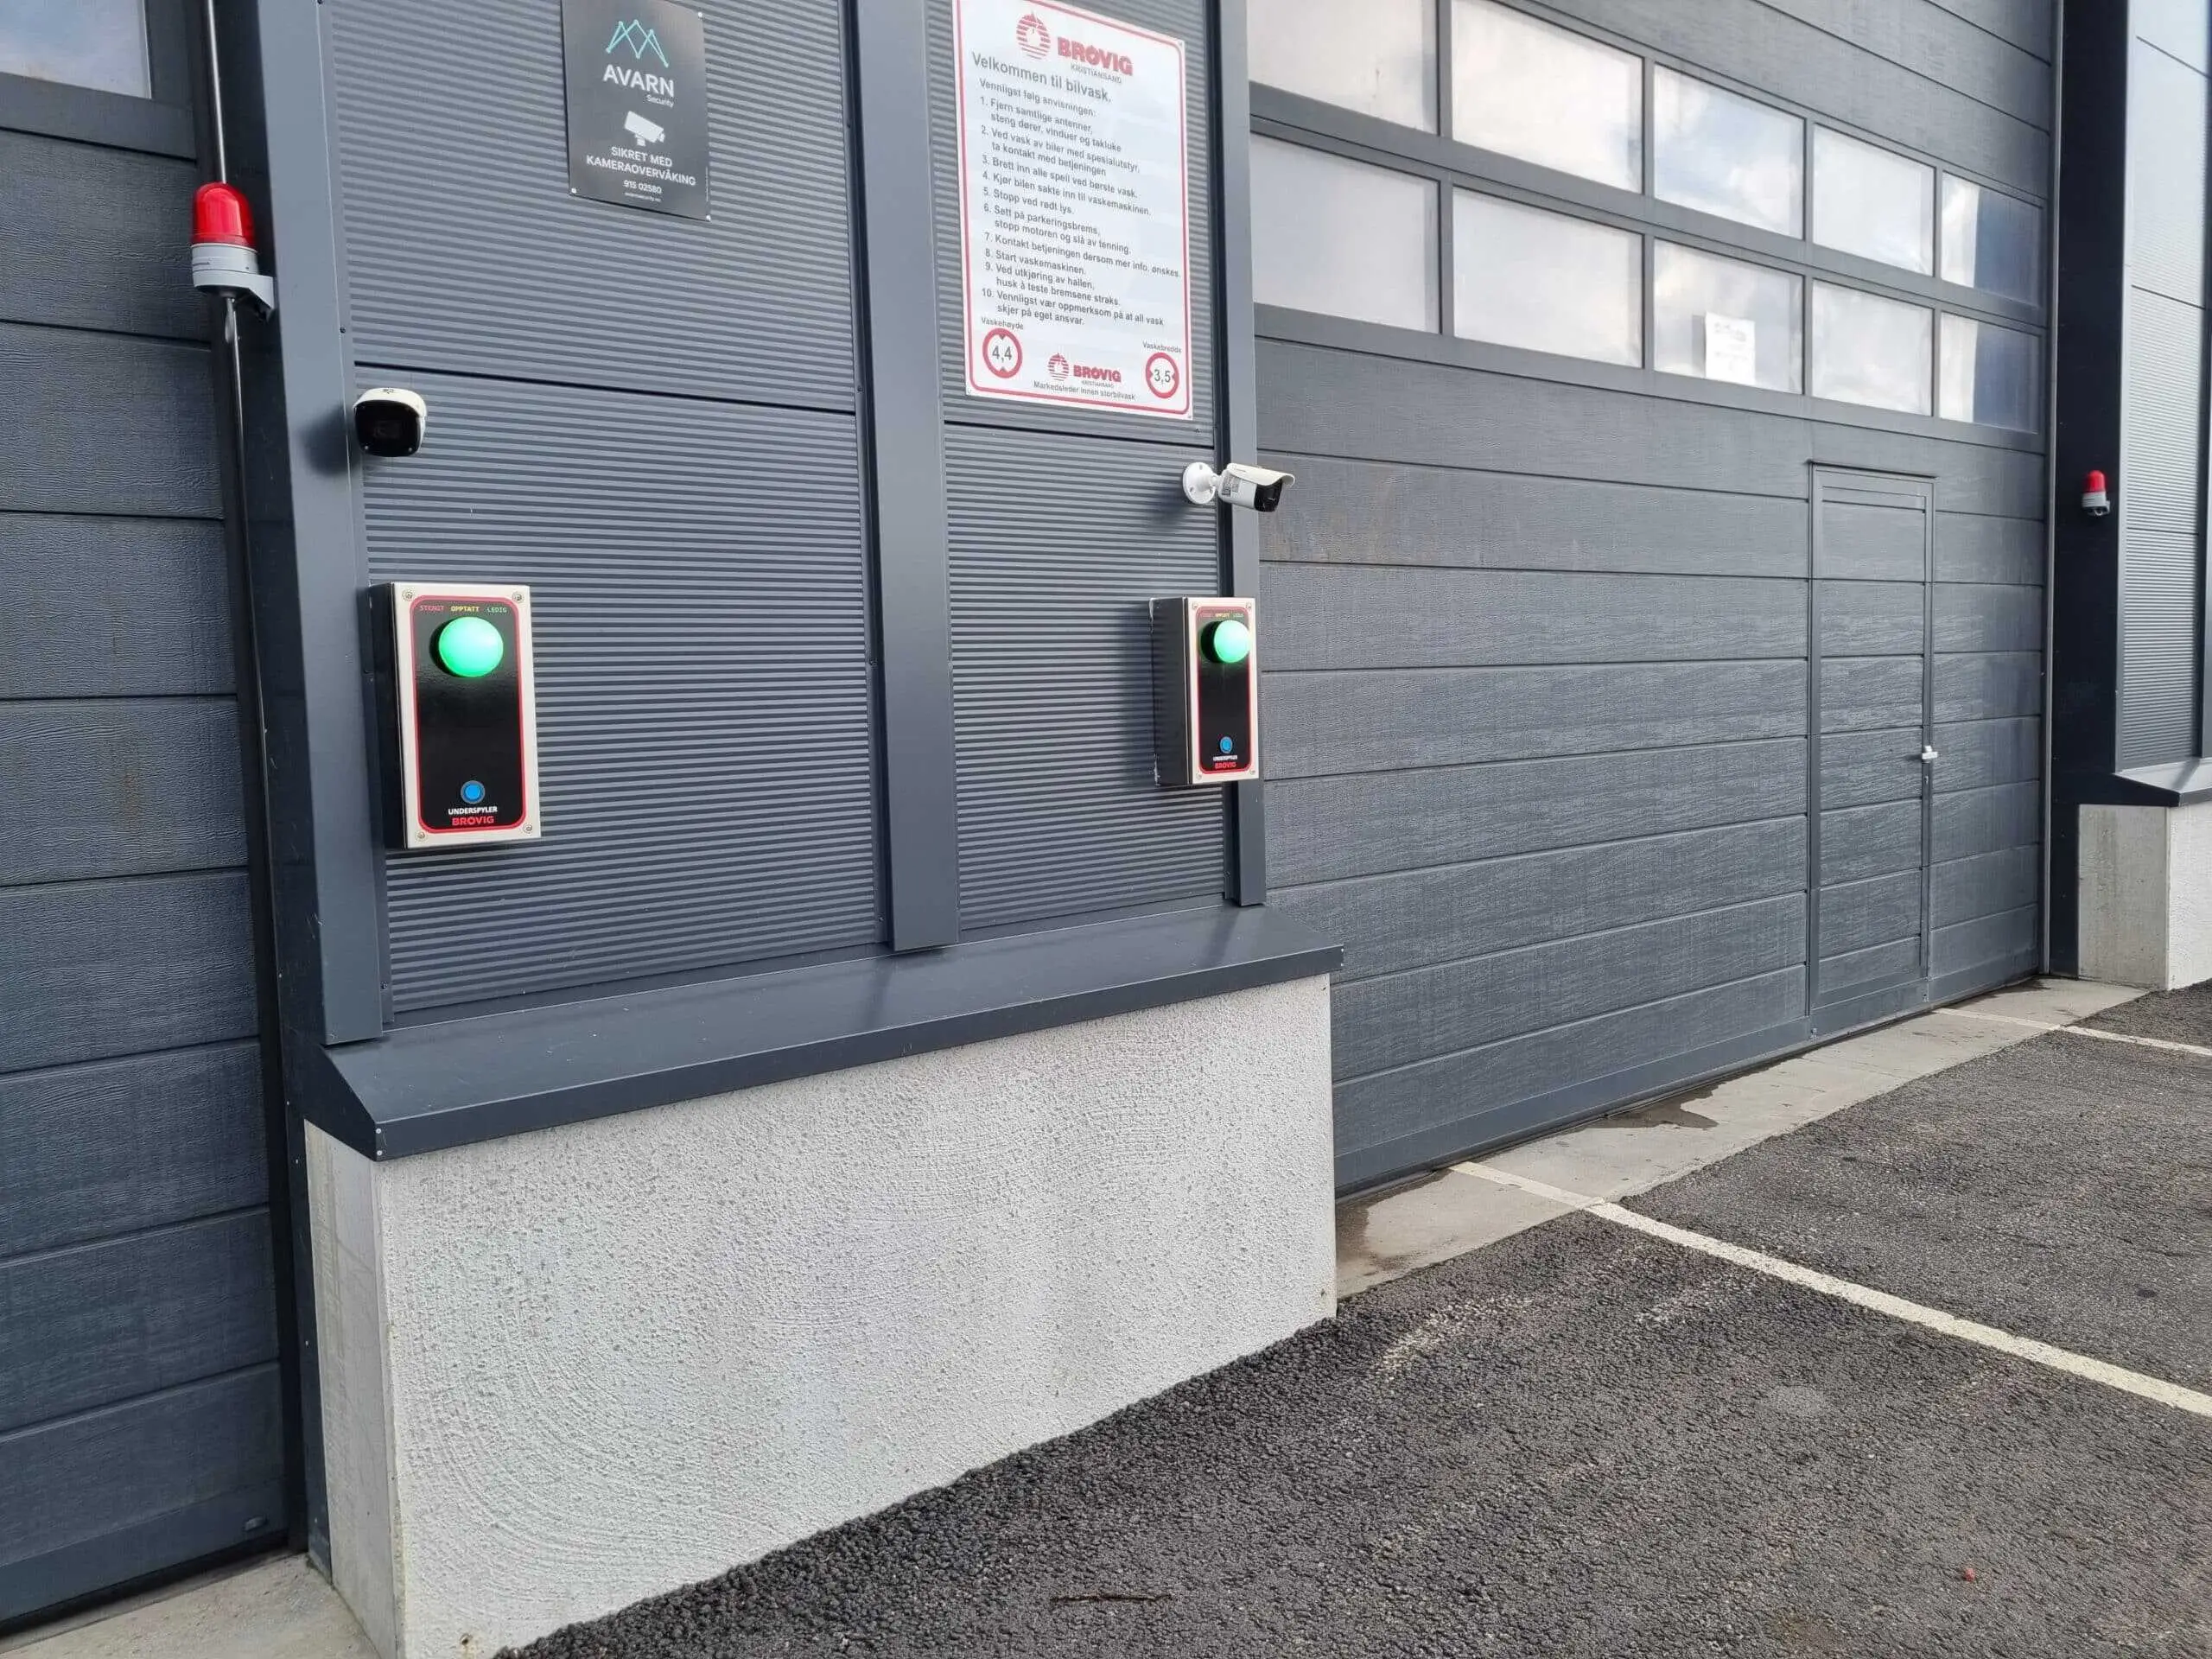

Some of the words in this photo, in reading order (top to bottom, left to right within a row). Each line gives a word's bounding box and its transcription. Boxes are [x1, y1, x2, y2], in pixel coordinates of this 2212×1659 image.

[603, 64, 674, 98] AVARN
[973, 51, 1046, 85] Velkommen
[1051, 74, 1062, 88] til
[980, 78, 1020, 97] Vennligst
[1023, 90, 1040, 104] følg
[991, 98, 1013, 111] Fjern
[1016, 106, 1052, 123] samtlige
[982, 124, 988, 135] 2.
[991, 128, 1007, 139] Ved
[1011, 134, 1030, 145] vask
[1046, 141, 1065, 153] biler
[1067, 148, 1084, 158] med
[991, 114, 1015, 127] steng
[1046, 127, 1077, 140] vinduer
[1080, 137, 1090, 146] og
[1092, 138, 1122, 152] takluke
[611, 146, 648, 162] SIKRET
[650, 155, 672, 167] MED
[992, 142, 1001, 151] ta
[1002, 143, 1035, 159] kontakt
[1038, 154, 1056, 164] med
[1058, 157, 1106, 175] betjeningen
[587, 155, 696, 186] KAMERAOVERVÅKING
[982, 155, 989, 165] 3.
[993, 157, 1014, 170] Brett
[1017, 162, 1030, 174] inn
[1033, 168, 1047, 177] alle
[1050, 173, 1070, 183] speil
[1072, 177, 1086, 187] ved
[1090, 180, 1115, 194] børste
[1118, 188, 1137, 198] vask.
[623, 180, 637, 189] 915
[639, 183, 662, 194] 02580
[983, 171, 990, 180] 4.
[994, 173, 1011, 185] Kjør
[1014, 179, 1035, 189] bilen
[1038, 185, 1060, 195] sakte
[1063, 190, 1076, 199] inn
[1089, 197, 1151, 215] vaskemaskinen.
[984, 203, 991, 213] 6.
[995, 205, 1012, 216] Sett
[1014, 211, 1025, 219] på
[994, 188, 1020, 204] Stopp
[1022, 197, 1038, 206] ved
[1040, 200, 1057, 210] rødt
[1060, 202, 1075, 214] lys.
[995, 220, 1020, 232] stopp
[1022, 226, 1058, 238] motoren
[1060, 233, 1071, 243] og
[1073, 235, 1085, 245] slå
[1099, 240, 1131, 255] tenning.
[985, 232, 993, 242] 7.
[995, 234, 1029, 249] Kontakt
[1032, 242, 1081, 258] betjeningen
[1084, 251, 1114, 265] dersom
[1116, 258, 1130, 268] mer
[1133, 262, 1149, 272] info.
[1152, 265, 1180, 277] ønskes.
[985, 248, 994, 257] 8.
[996, 250, 1016, 262] Start
[1020, 257, 1086, 275] vaskemaskinen.
[985, 262, 994, 271] 9.
[995, 263, 1012, 275] Ved
[1015, 268, 1052, 283] utkjøring
[996, 276, 1017, 288] husk
[1020, 280, 1025, 289] å
[1028, 283, 1048, 293] teste
[1051, 286, 1091, 301] bremsene
[1094, 295, 1121, 305] straks.
[982, 288, 994, 297] 10.
[997, 290, 1038, 305] Vennligst
[1039, 299, 1056, 308] vær
[1058, 302, 1111, 316] oppmerksom
[1114, 311, 1123, 321] på
[1147, 317, 1164, 326] vask
[997, 304, 1019, 315] skjer
[1021, 308, 1031, 317] på
[1034, 312, 1052, 321] eget
[1055, 314, 1084, 325] ansvar.
[981, 317, 1023, 329] Vaskehøyde
[992, 346, 1012, 363] 4,4
[1142, 340, 1181, 353] Vaskebredde
[1154, 369, 1171, 384] 3,5
[1034, 380, 1078, 392] Markedsleder
[1100, 390, 1135, 400] storbilvask
[448, 806, 498, 815] UNDERSPYLER
